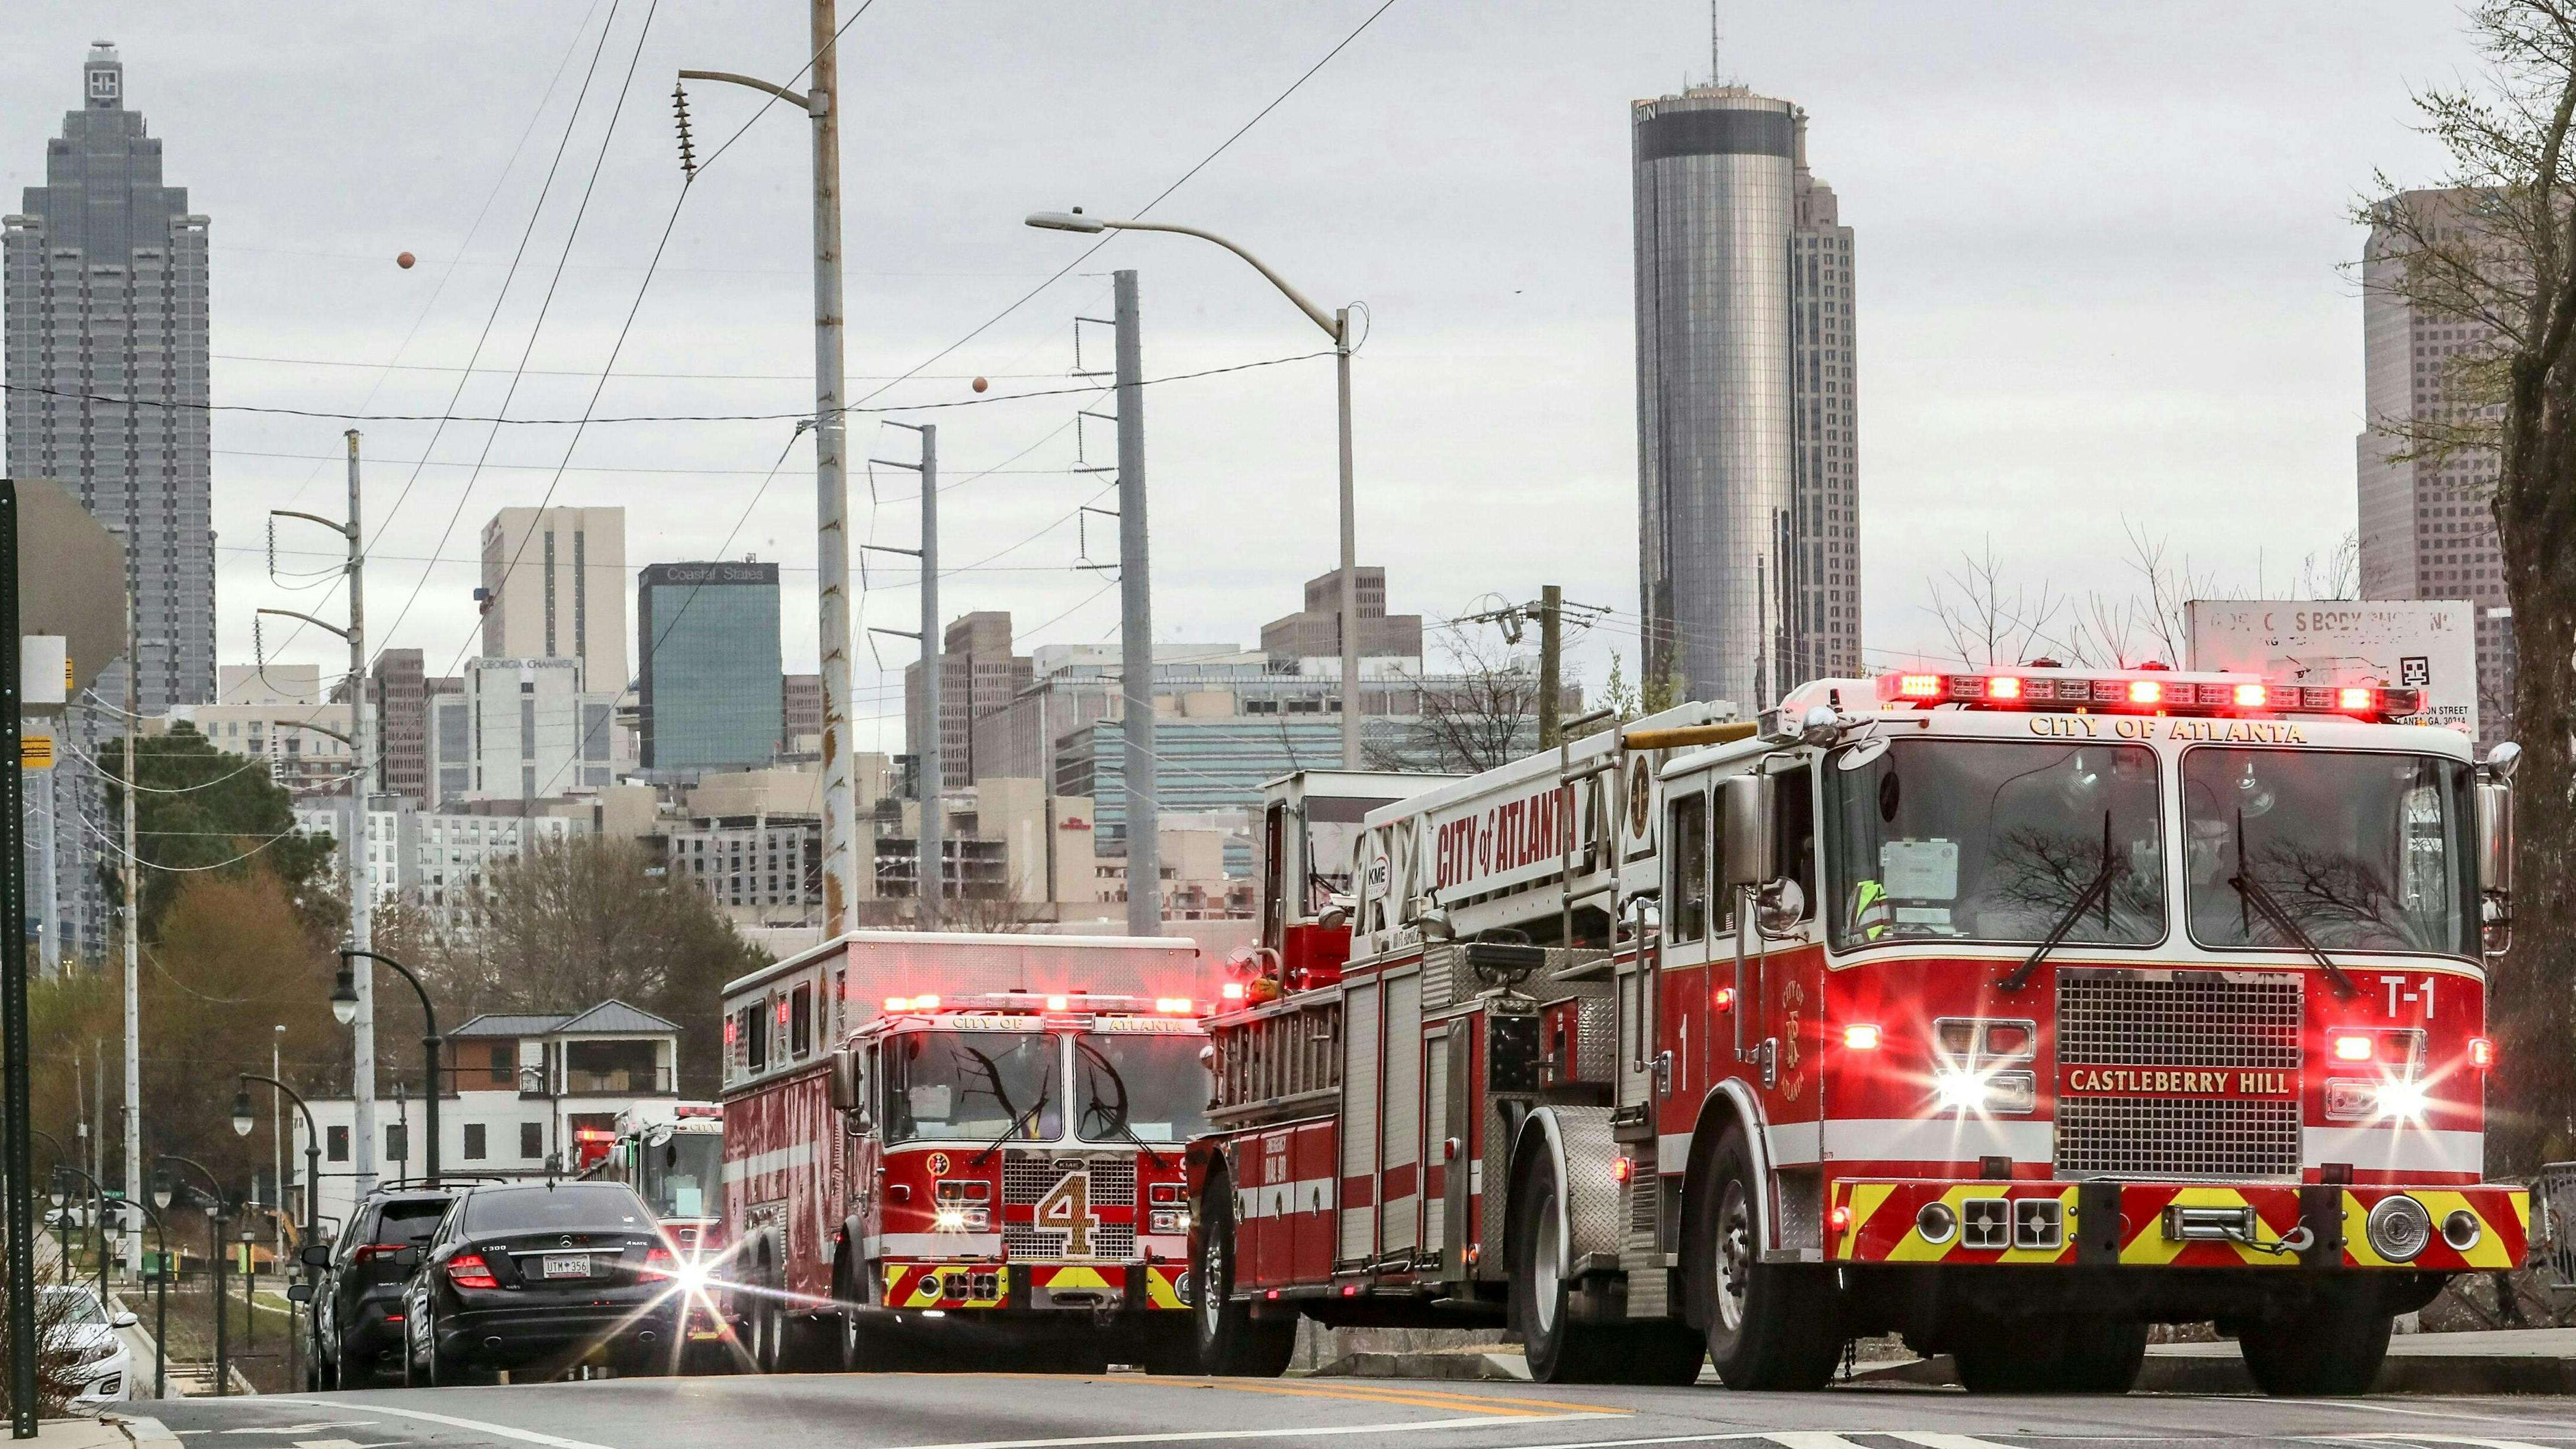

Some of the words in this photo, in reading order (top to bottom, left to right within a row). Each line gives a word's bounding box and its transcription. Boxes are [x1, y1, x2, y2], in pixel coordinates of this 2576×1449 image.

[667, 568, 716, 580] Coastal
[723, 567, 764, 580] States
[481, 660, 523, 668] GEORGIA
[2439, 706, 2468, 714] STREET
[2030, 715, 2099, 737] CITY
[2115, 719, 2156, 739] OF
[2169, 720, 2308, 743] ATLANTA
[1436, 814, 1478, 890] CITY
[1479, 809, 1495, 877] of
[1368, 866, 1385, 886] KME
[1783, 980, 1796, 1009] CITY
[1796, 983, 1805, 1006] OF
[2380, 976, 2434, 1019] T-1
[953, 1019, 990, 1029] CITY
[1000, 1019, 1023, 1029] OF
[1109, 1019, 1185, 1032] ATLANTA
[1680, 1013, 1687, 1091] 1
[2070, 1070, 2230, 1093] CASTLEBERRY
[2239, 1072, 2289, 1094] HILL
[690, 1123, 716, 1132] CITY
[1034, 1171, 1100, 1261] 4
[547, 1261, 563, 1271] UTM
[571, 1261, 587, 1271] 356
